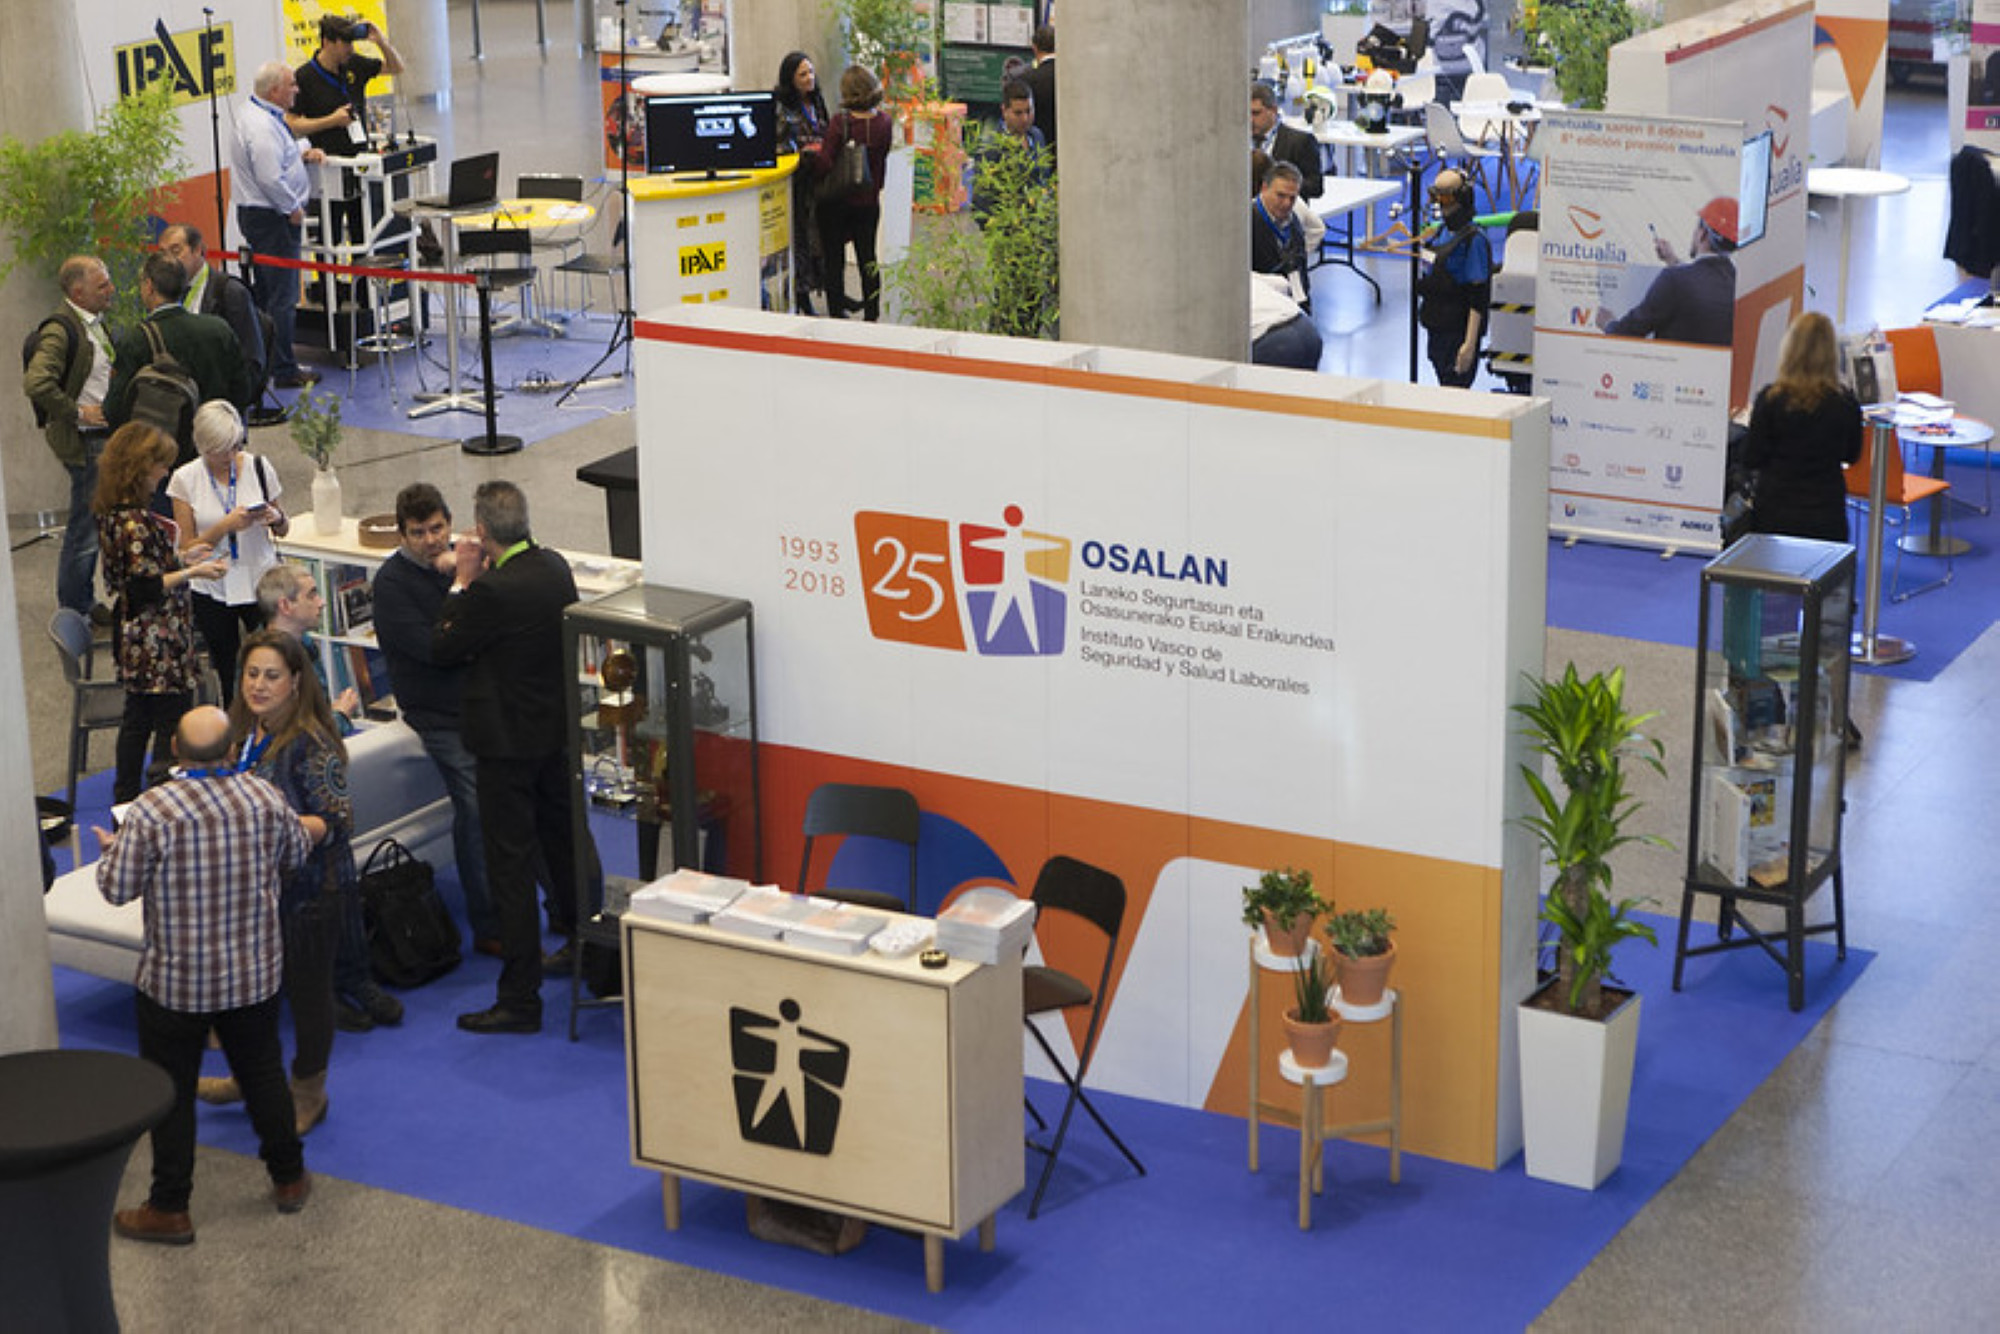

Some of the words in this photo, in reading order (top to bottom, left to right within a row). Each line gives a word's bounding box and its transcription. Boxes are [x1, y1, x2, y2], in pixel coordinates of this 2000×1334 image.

[117, 18, 224, 98] IPAF
[1547, 117, 1602, 131] mutualia
[1678, 143, 1736, 157] mutualia
[681, 248, 725, 275] IPAF
[1542, 241, 1626, 262] mutualia
[780, 536, 840, 565] 1993
[1081, 541, 1228, 587] OSALAN
[785, 568, 846, 598] 2018
[871, 536, 946, 622] 25
[1080, 580, 1138, 602] Laneko
[1142, 589, 1234, 617] Segurtasun
[1237, 606, 1264, 622] eta
[1080, 599, 1185, 629] Osasunerako
[1189, 616, 1243, 638] Euskal
[1246, 623, 1336, 652] Erakundea
[1080, 627, 1145, 650] Instituto
[1148, 636, 1198, 658] Vasco
[1202, 645, 1223, 662] de
[1080, 646, 1160, 673] Seguridad
[1165, 661, 1176, 677] y
[1179, 661, 1226, 683] Salud
[1229, 668, 1311, 695] Laborales
